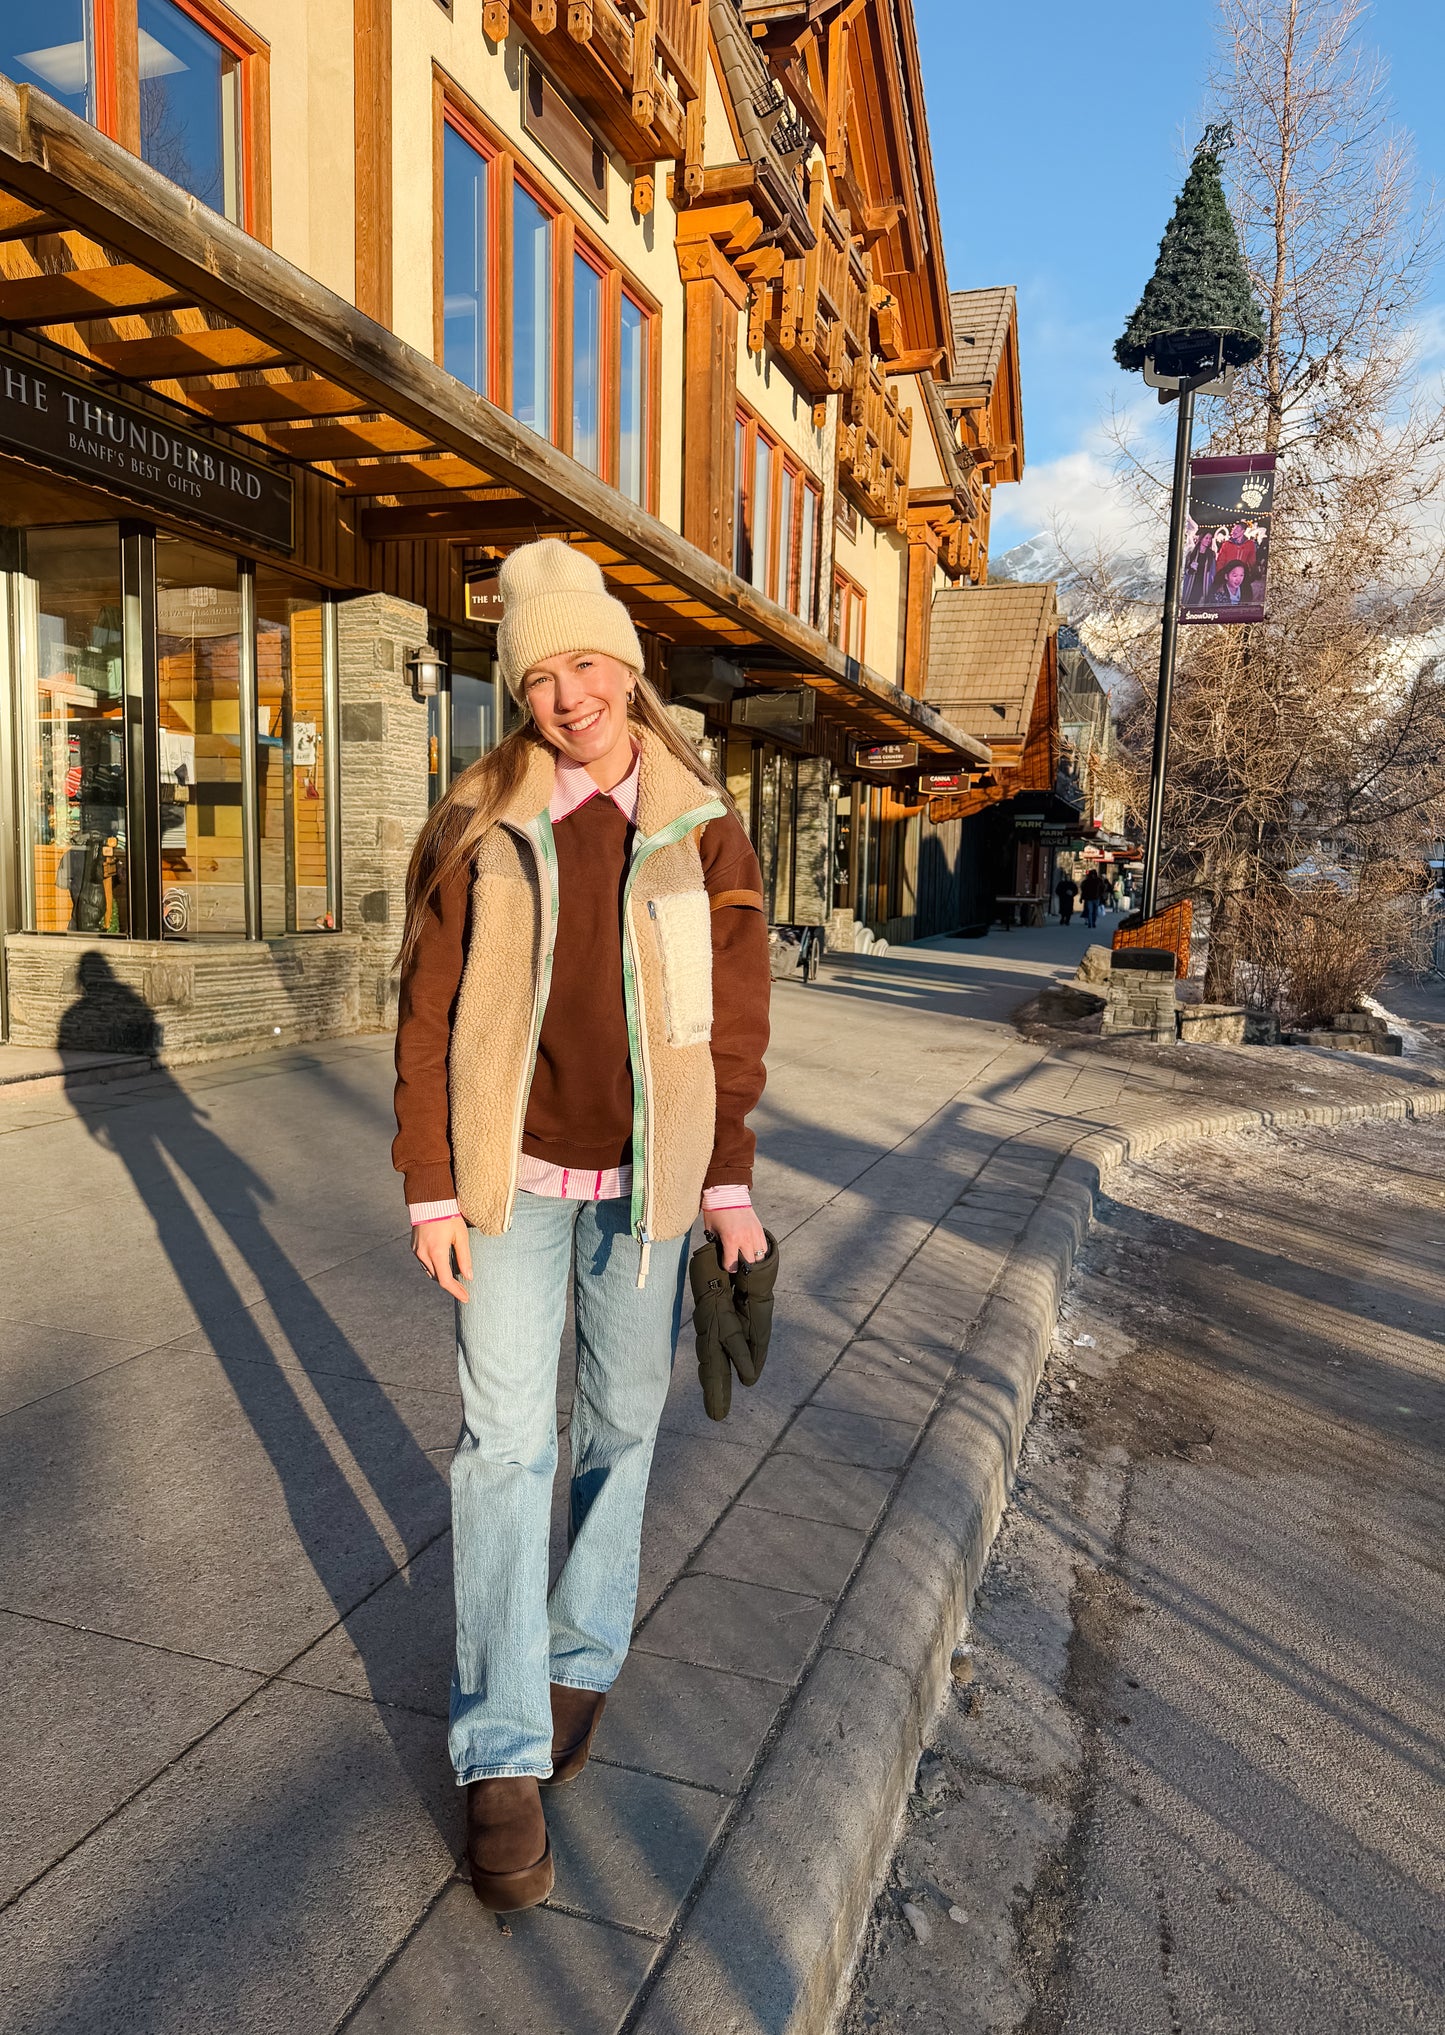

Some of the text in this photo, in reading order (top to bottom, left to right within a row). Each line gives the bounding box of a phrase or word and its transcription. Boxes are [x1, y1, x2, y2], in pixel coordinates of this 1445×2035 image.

[0, 364, 261, 500] HE THUNDERBIRD
[69, 432, 202, 498] BANFF'S BEST GIFTS
[472, 595, 488, 604] THE
[1015, 821, 1042, 829] PARK
